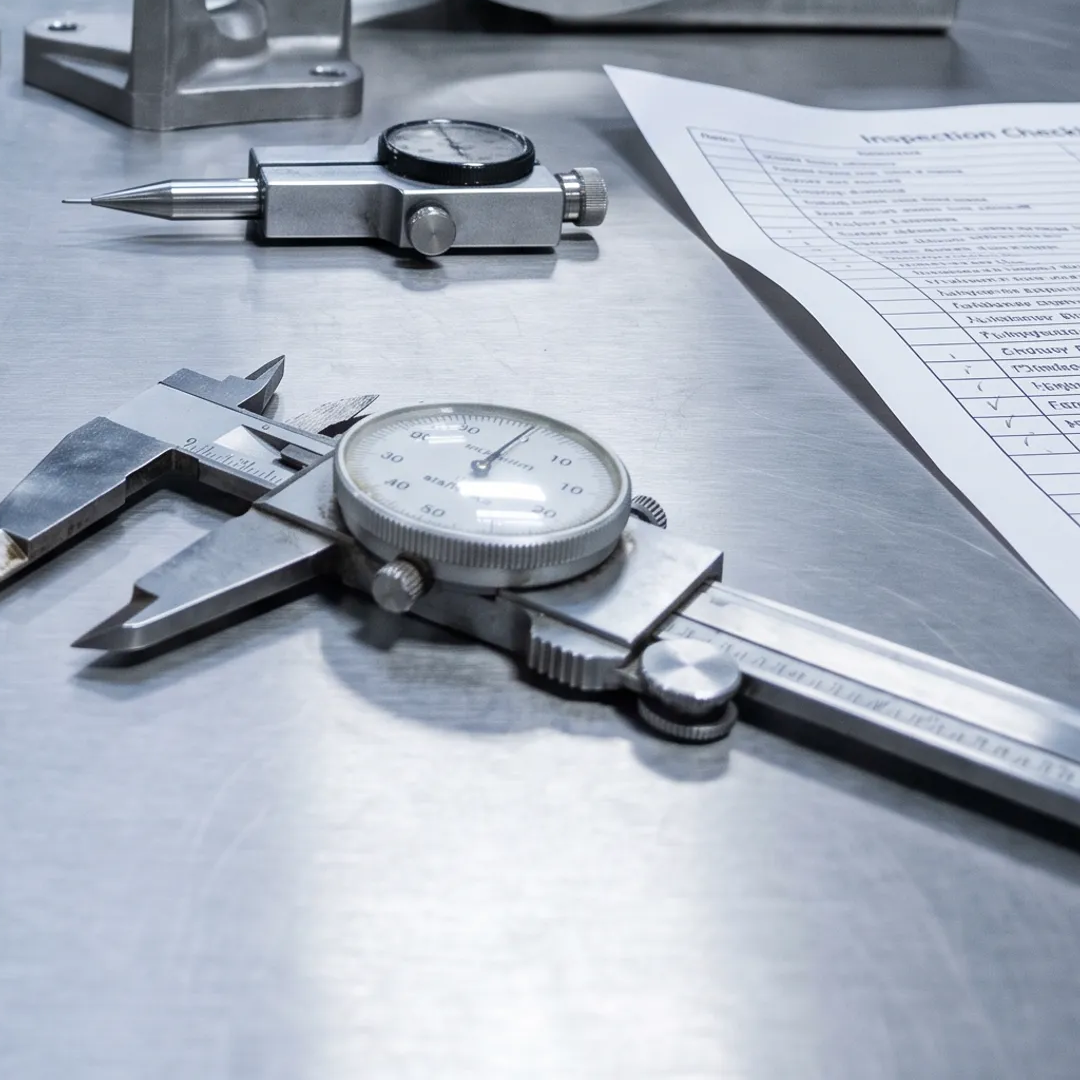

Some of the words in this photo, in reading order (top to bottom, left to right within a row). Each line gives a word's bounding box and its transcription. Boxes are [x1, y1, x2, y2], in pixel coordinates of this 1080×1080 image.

[860, 130, 997, 145] Inspection
[380, 450, 404, 463] 30
[551, 454, 572, 466] 10
[561, 482, 584, 495] 10
